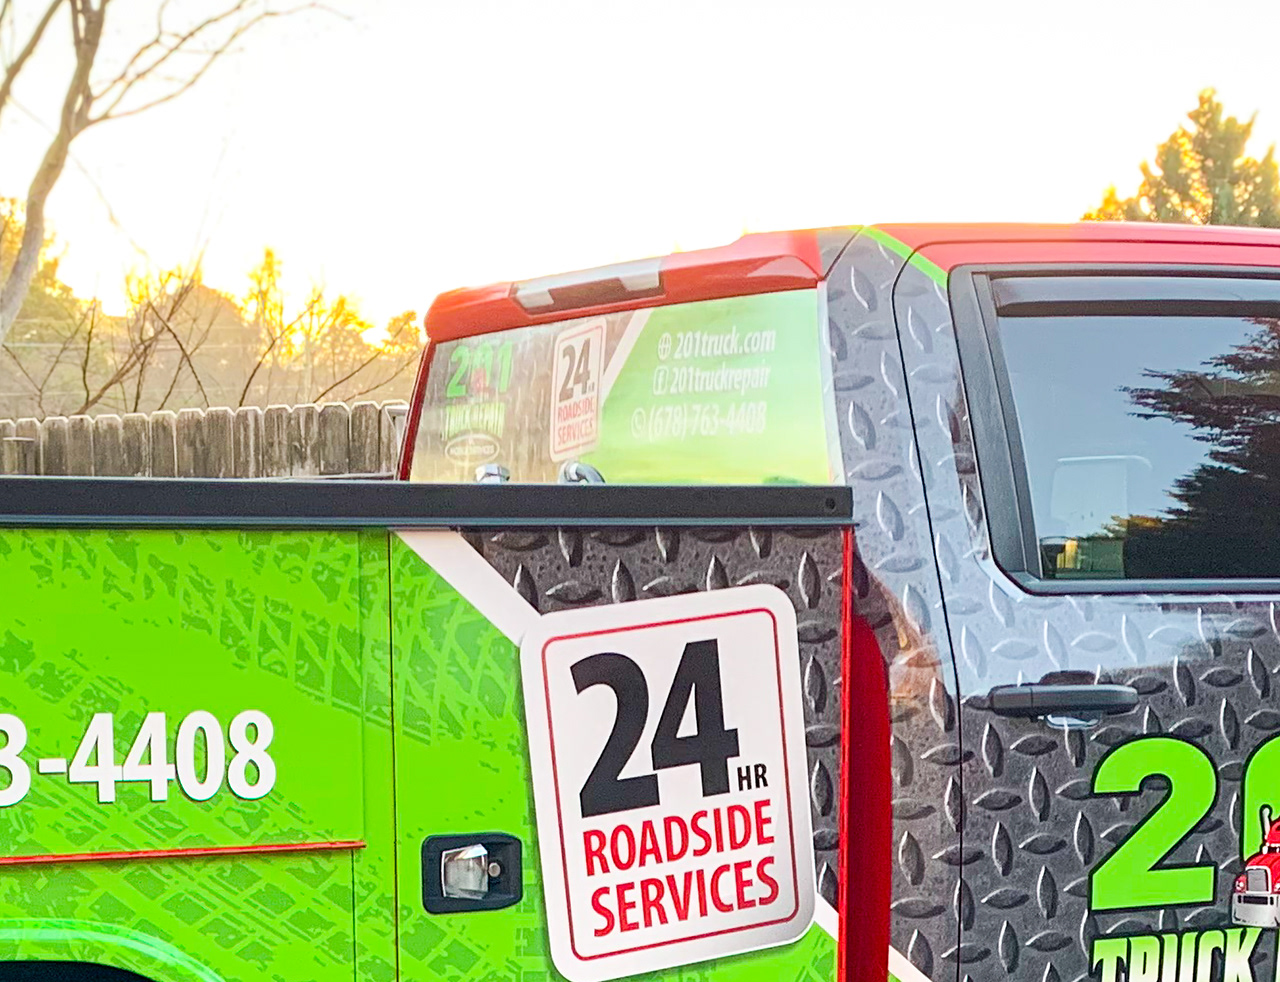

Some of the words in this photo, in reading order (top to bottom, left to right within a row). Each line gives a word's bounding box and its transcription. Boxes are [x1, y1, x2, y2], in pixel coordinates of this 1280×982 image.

[673, 325, 776, 360] 201truck.com
[446, 340, 513, 398] 201
[558, 337, 591, 403] 24
[669, 359, 770, 396] 201truckrepair
[557, 396, 595, 425] ROADSIDE
[557, 417, 594, 446] SERVICES
[648, 403, 687, 443] (678)
[691, 401, 767, 436] 763-4408
[569, 638, 740, 819] 24
[736, 762, 769, 792] HR
[582, 798, 776, 877] ROADSIDE
[591, 855, 780, 938] SERVICES
